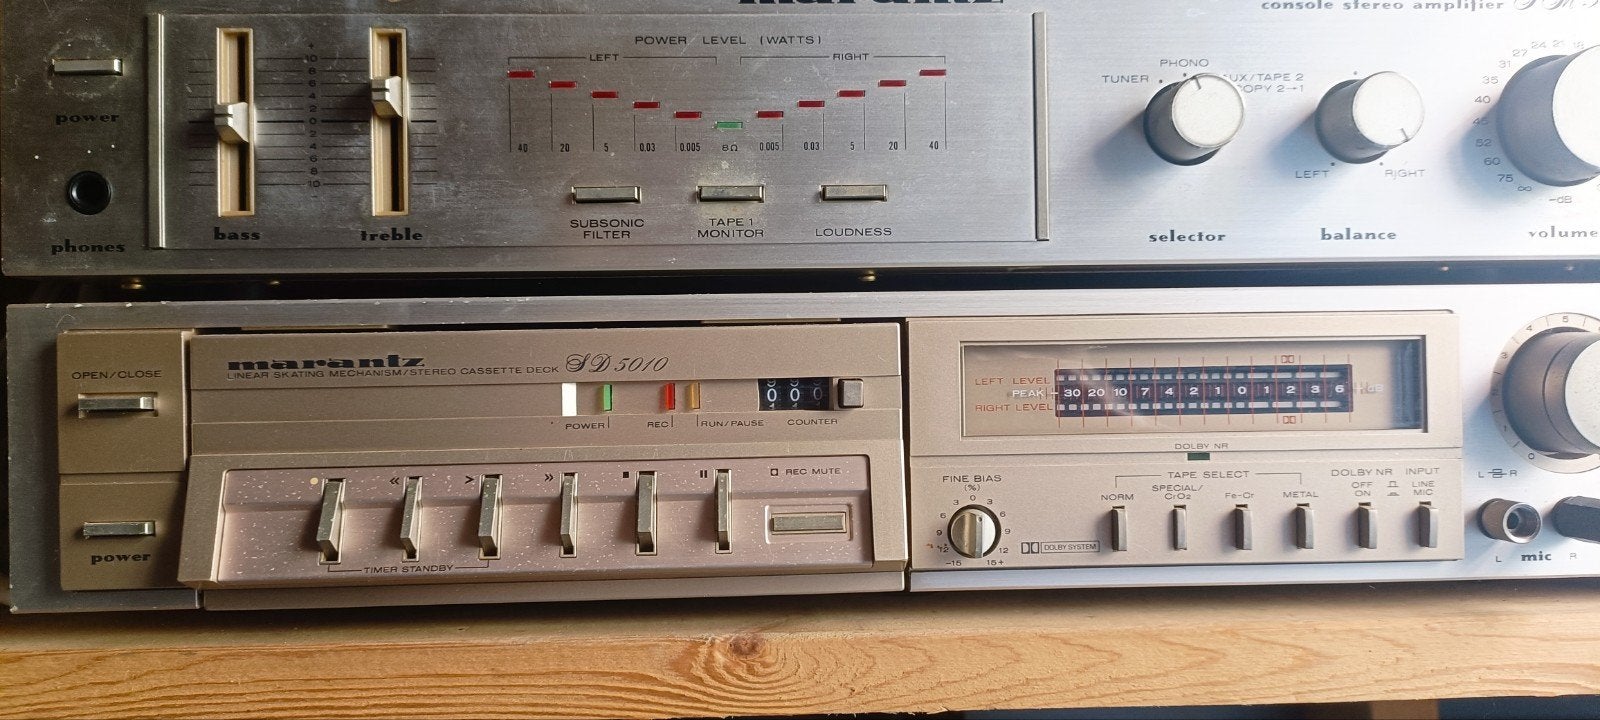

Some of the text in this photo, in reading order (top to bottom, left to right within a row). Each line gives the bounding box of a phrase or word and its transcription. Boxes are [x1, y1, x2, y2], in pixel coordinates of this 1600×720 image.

[1261, 0, 1332, 9] console
[1343, 0, 1403, 10] stereo
[1412, 0, 1504, 11] amplifier
[635, 35, 822, 45] POWER LEVEL (WATTS)
[589, 52, 619, 62] LEFT
[832, 52, 869, 62] RIGHT
[1160, 58, 1209, 68] PHONO
[1102, 74, 1149, 84] TUNER
[1474, 95, 1491, 104] 40
[56, 113, 119, 125] power
[518, 143, 528, 152] 40
[560, 143, 570, 152] 20
[604, 143, 609, 152] 5
[639, 143, 656, 152] 0.03
[679, 142, 701, 152] 0.005
[759, 142, 780, 151] 0.005
[803, 142, 820, 151] 0.03
[850, 142, 855, 151] 5
[888, 141, 898, 150] 20
[929, 141, 939, 150] 40
[1484, 157, 1501, 166] 60
[1295, 170, 1330, 179] LEFT
[1498, 173, 1514, 183] 75
[570, 219, 645, 228] SUBSONIC
[709, 218, 744, 227] TAPE
[213, 227, 261, 241] bass
[360, 227, 423, 241] treble
[583, 230, 631, 239] FILTER
[697, 229, 764, 238] MONITOR
[815, 228, 892, 237] LOUDNESS
[1149, 229, 1226, 242] selector
[1320, 227, 1397, 241] balance
[1529, 225, 1598, 238] volume
[51, 239, 126, 253] phones
[228, 354, 425, 371] marantz
[614, 356, 670, 372] 5010
[71, 370, 162, 380] OPEN/CLOSE
[227, 372, 269, 380] LINEAR
[273, 370, 324, 379] SKATING
[460, 366, 523, 375] CASSETTE
[526, 366, 559, 374] DECK
[975, 376, 1051, 386] LEFT LEVEL
[1011, 389, 1045, 398] PEAK
[1064, 388, 1082, 398] 30
[1088, 388, 1106, 398] 20
[1113, 387, 1128, 397] 10
[1140, 387, 1150, 397] 7
[1165, 387, 1174, 396] 4
[1189, 387, 1199, 396] 2
[1215, 386, 1220, 395] 1
[1237, 386, 1247, 395] 0
[1263, 385, 1269, 394] 1
[1286, 385, 1296, 394] 2
[1310, 385, 1320, 394] 3
[1335, 384, 1345, 393] 6
[975, 403, 1053, 412] RIGHT LEVEL
[565, 422, 605, 430] POWER
[701, 420, 764, 428] RUN/PAUSE
[787, 418, 838, 426] COUNTER
[1214, 442, 1228, 450] NR
[811, 467, 841, 475] MUTE
[1168, 470, 1250, 479] TAPE SELECT
[1331, 468, 1393, 477] DOLBY NR
[1405, 467, 1440, 475] INPUT
[1509, 469, 1518, 477] R
[942, 474, 1002, 483] FINE BIAS
[1351, 481, 1373, 489] OFF
[1412, 480, 1435, 488] LINE
[1101, 493, 1134, 501] NORM
[1283, 490, 1319, 499] METAL
[91, 553, 151, 565] power
[1521, 551, 1552, 561] mic
[364, 564, 453, 574] TIMER STANDBY
